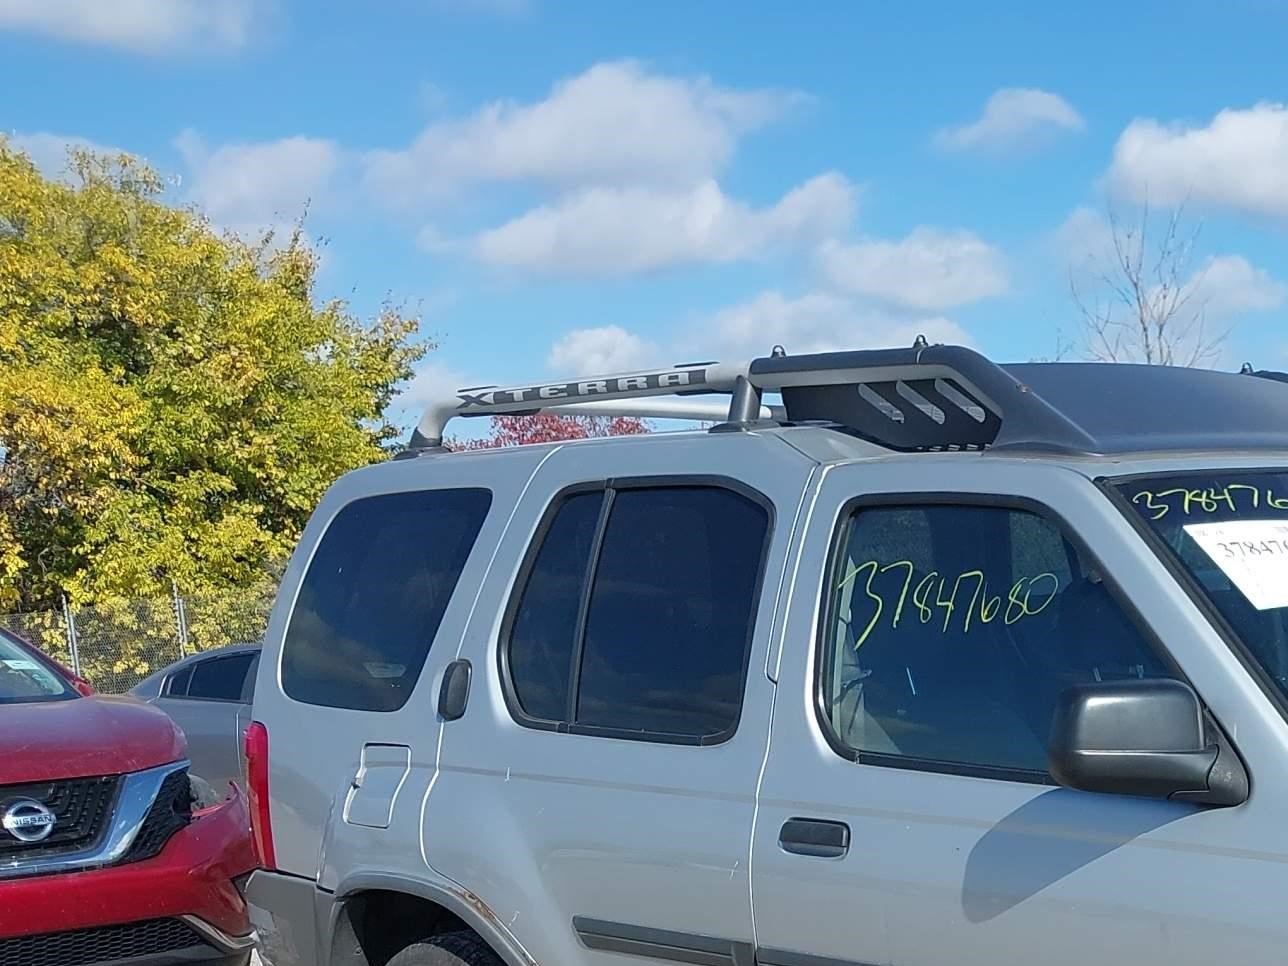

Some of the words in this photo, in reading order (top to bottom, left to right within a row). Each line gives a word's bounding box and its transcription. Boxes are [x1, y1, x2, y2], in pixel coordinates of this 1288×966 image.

[456, 369, 692, 409] XTERRA
[837, 560, 1059, 651] 37847680
[11, 814, 53, 826] NISSAN
